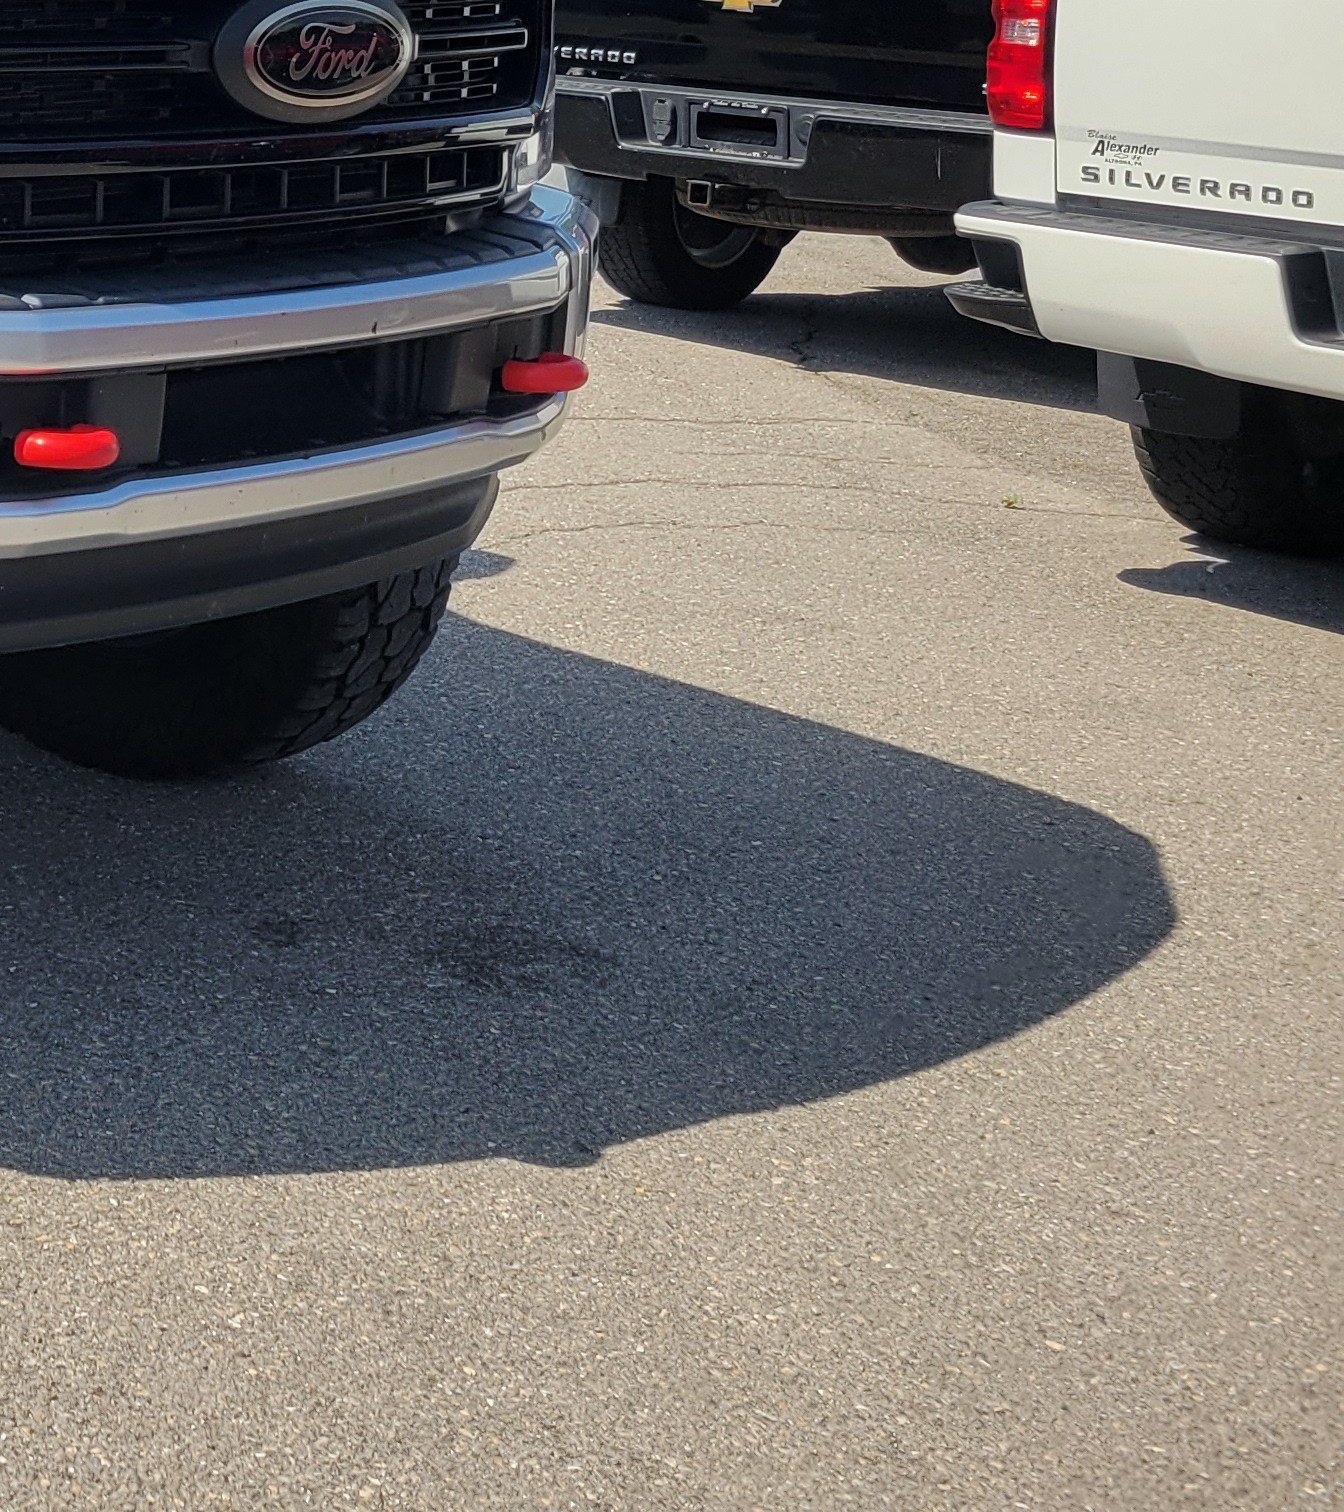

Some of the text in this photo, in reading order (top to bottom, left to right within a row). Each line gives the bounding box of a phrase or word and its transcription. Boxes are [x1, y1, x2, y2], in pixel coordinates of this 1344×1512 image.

[289, 22, 378, 81] Ford
[1087, 129, 1118, 141] Blaise
[1091, 139, 1160, 157] Alexander
[1080, 165, 1315, 210] SILVERADO
